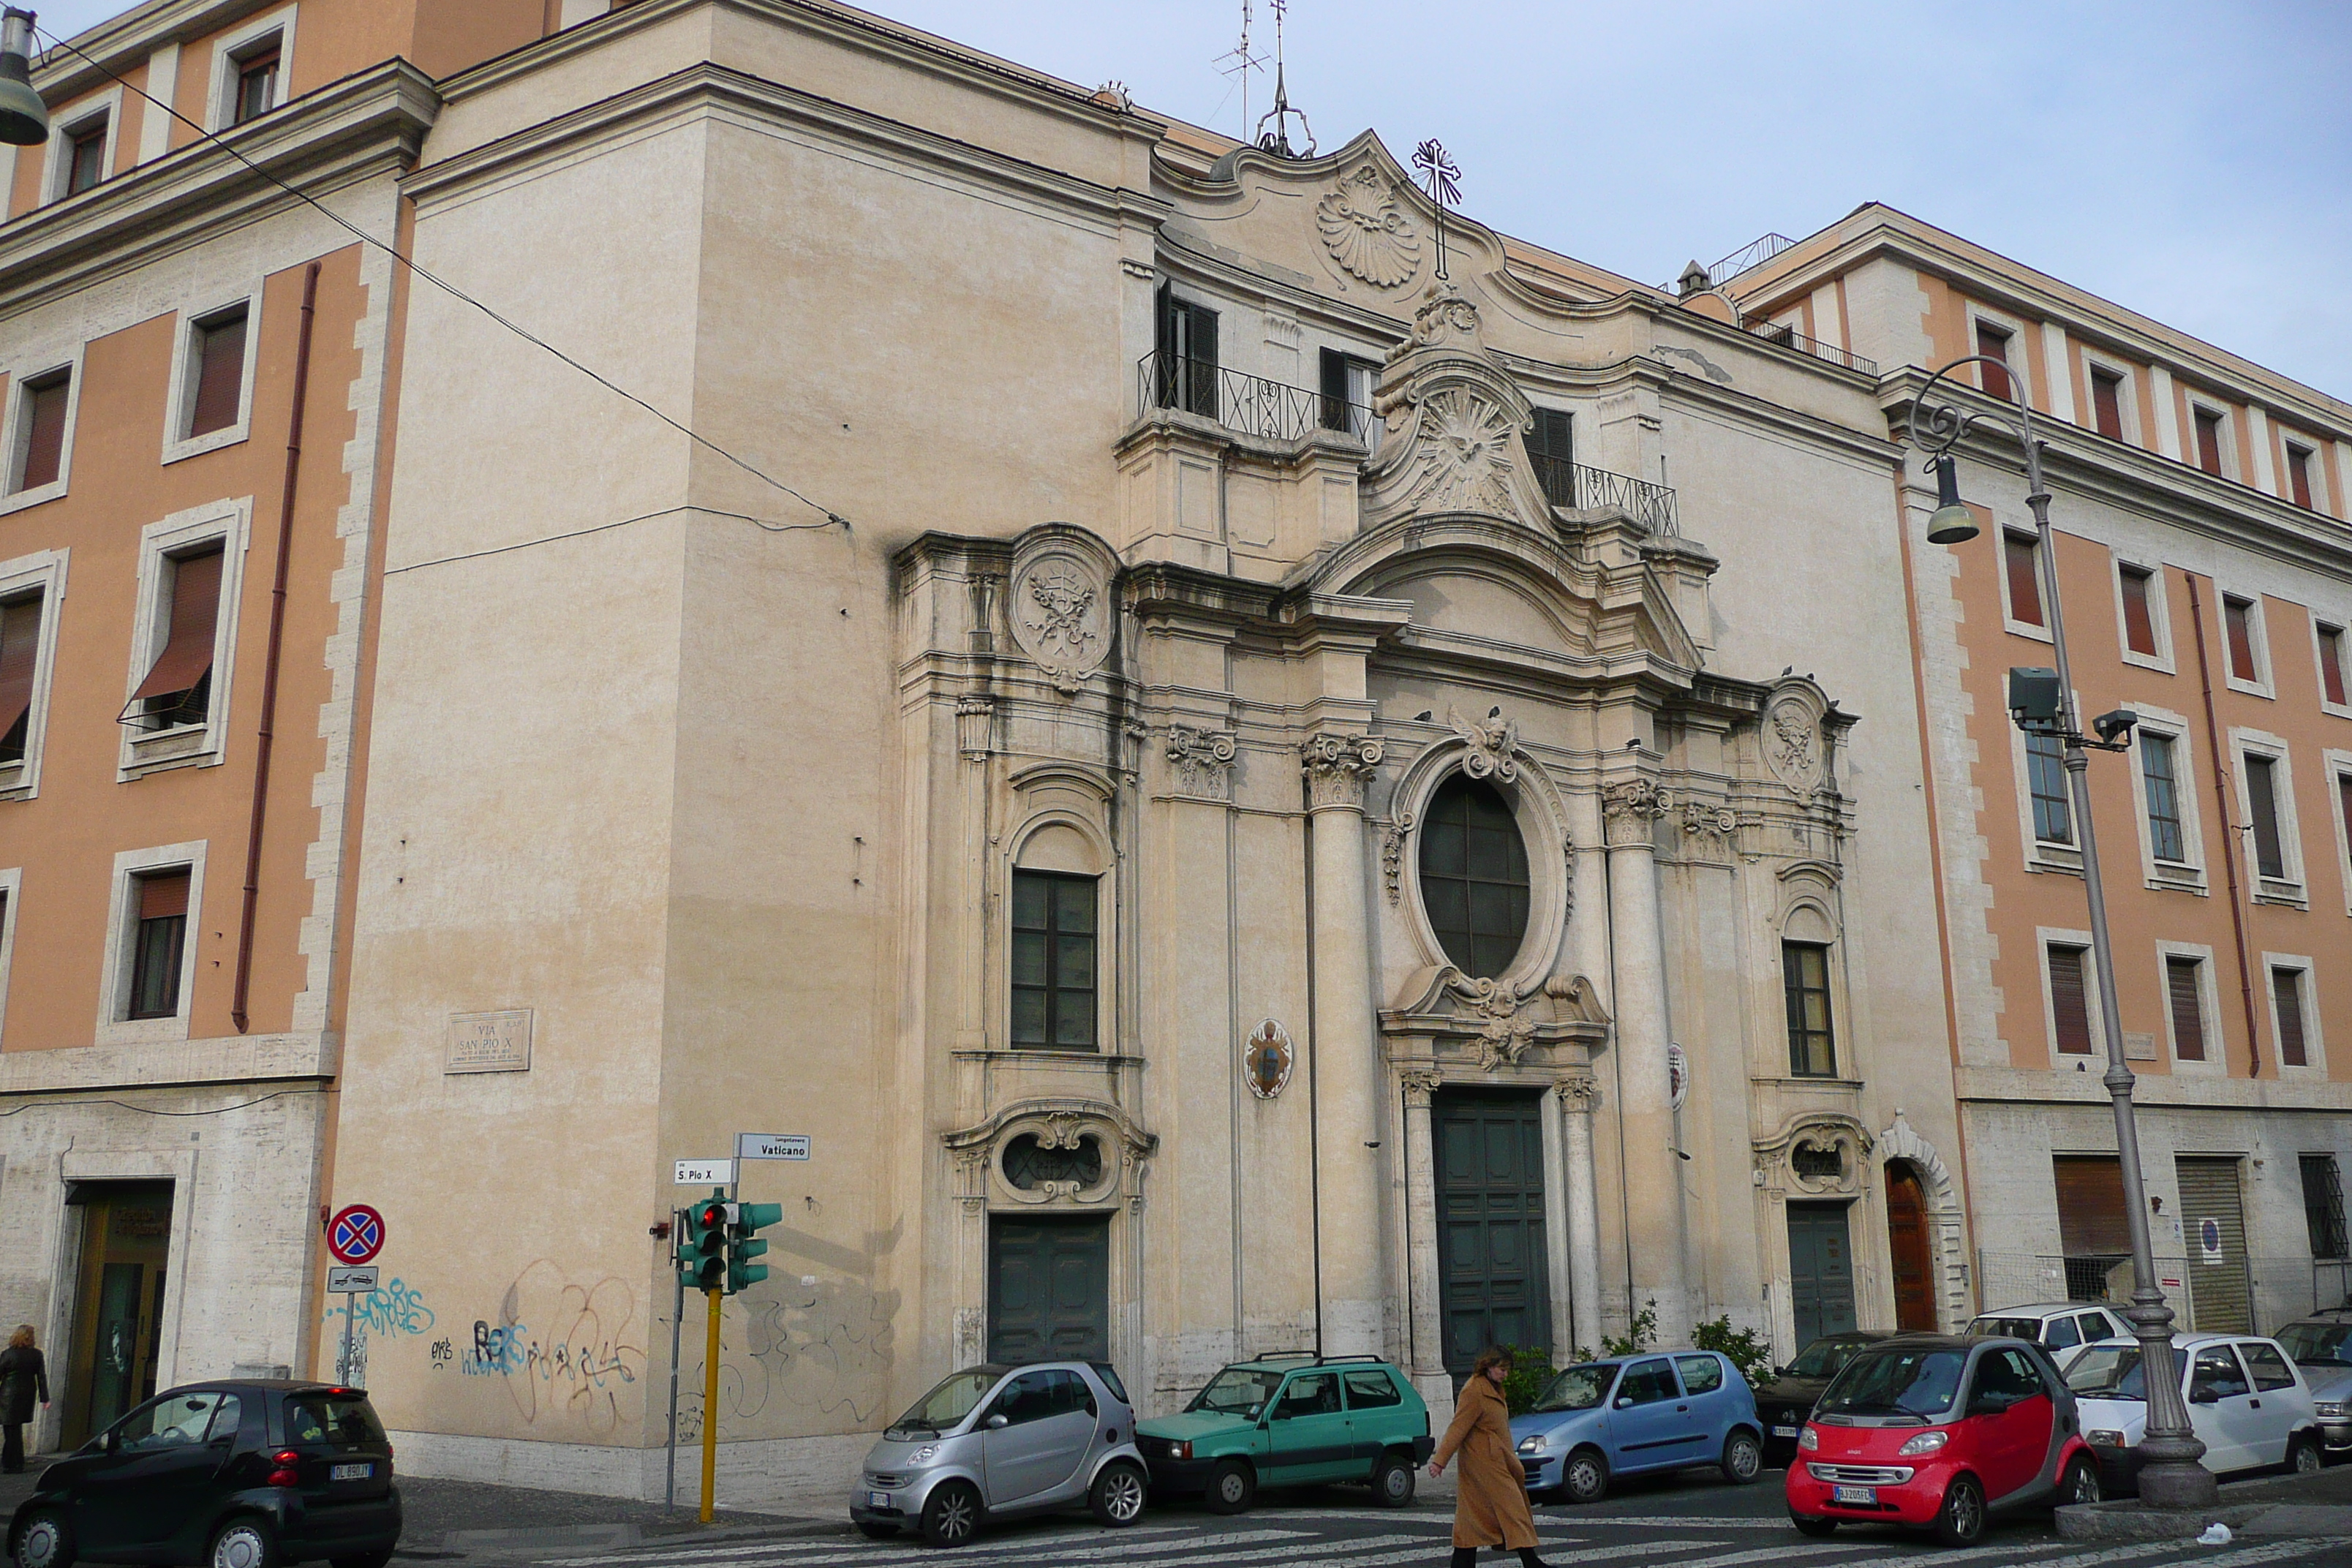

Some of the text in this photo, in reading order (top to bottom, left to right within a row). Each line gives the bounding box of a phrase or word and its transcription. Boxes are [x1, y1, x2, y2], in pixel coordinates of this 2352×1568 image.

[478, 1025, 495, 1035] VIA
[459, 1037, 512, 1050] SAN PIO X
[761, 1145, 805, 1156] Vaticano
[689, 1170, 702, 1180] Pio
[706, 1170, 712, 1180] X
